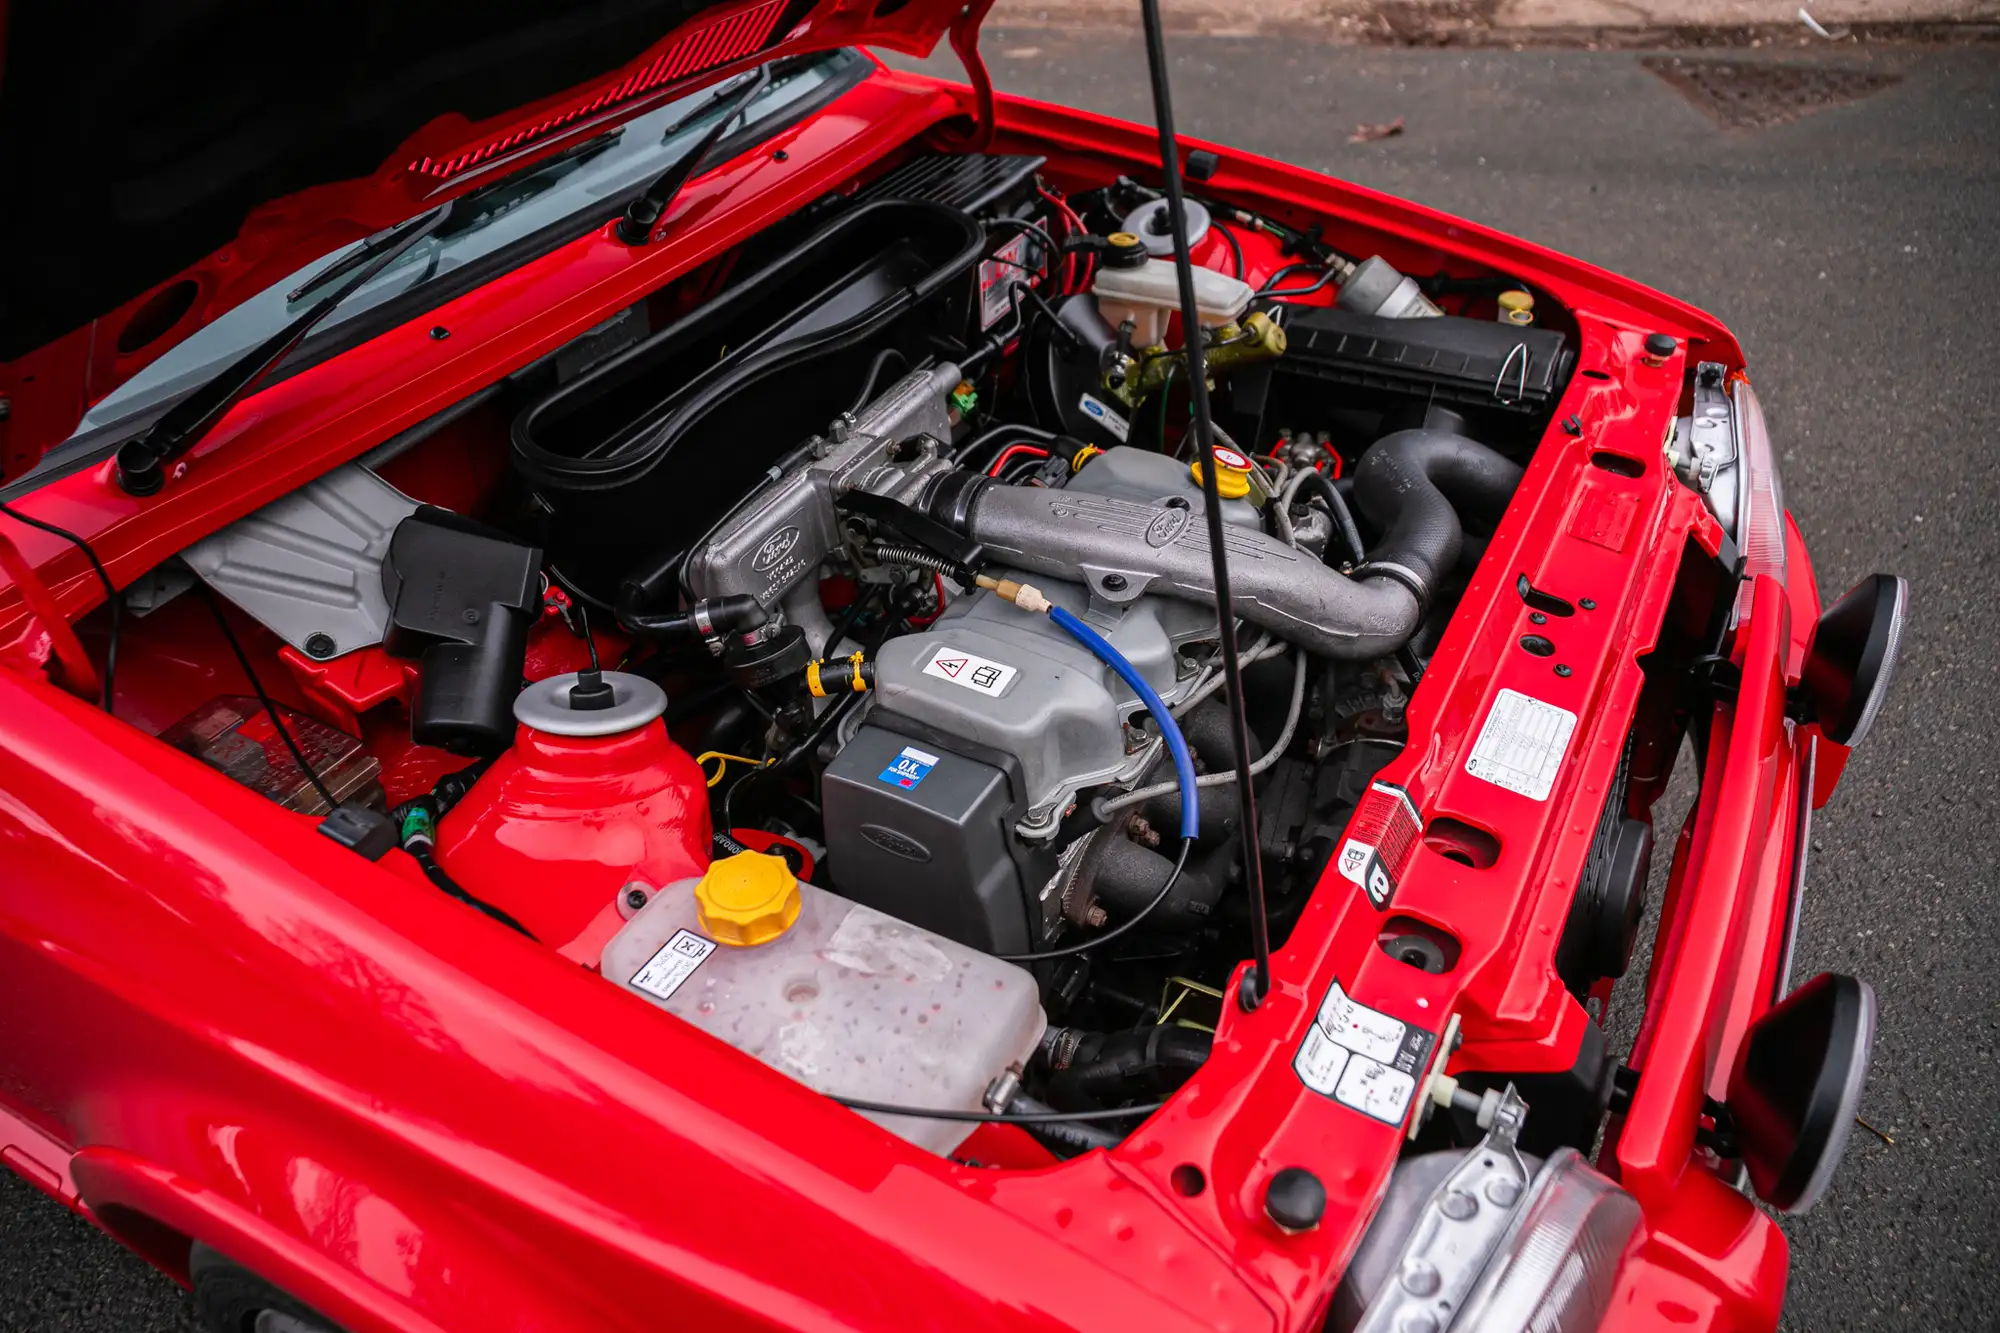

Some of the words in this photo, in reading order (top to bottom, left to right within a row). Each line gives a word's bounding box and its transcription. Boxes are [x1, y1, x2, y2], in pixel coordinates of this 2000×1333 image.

[1151, 513, 1182, 538] Ford
[763, 532, 790, 565] Ford
[898, 759, 920, 775] O.K.
[875, 831, 916, 856] Ford
